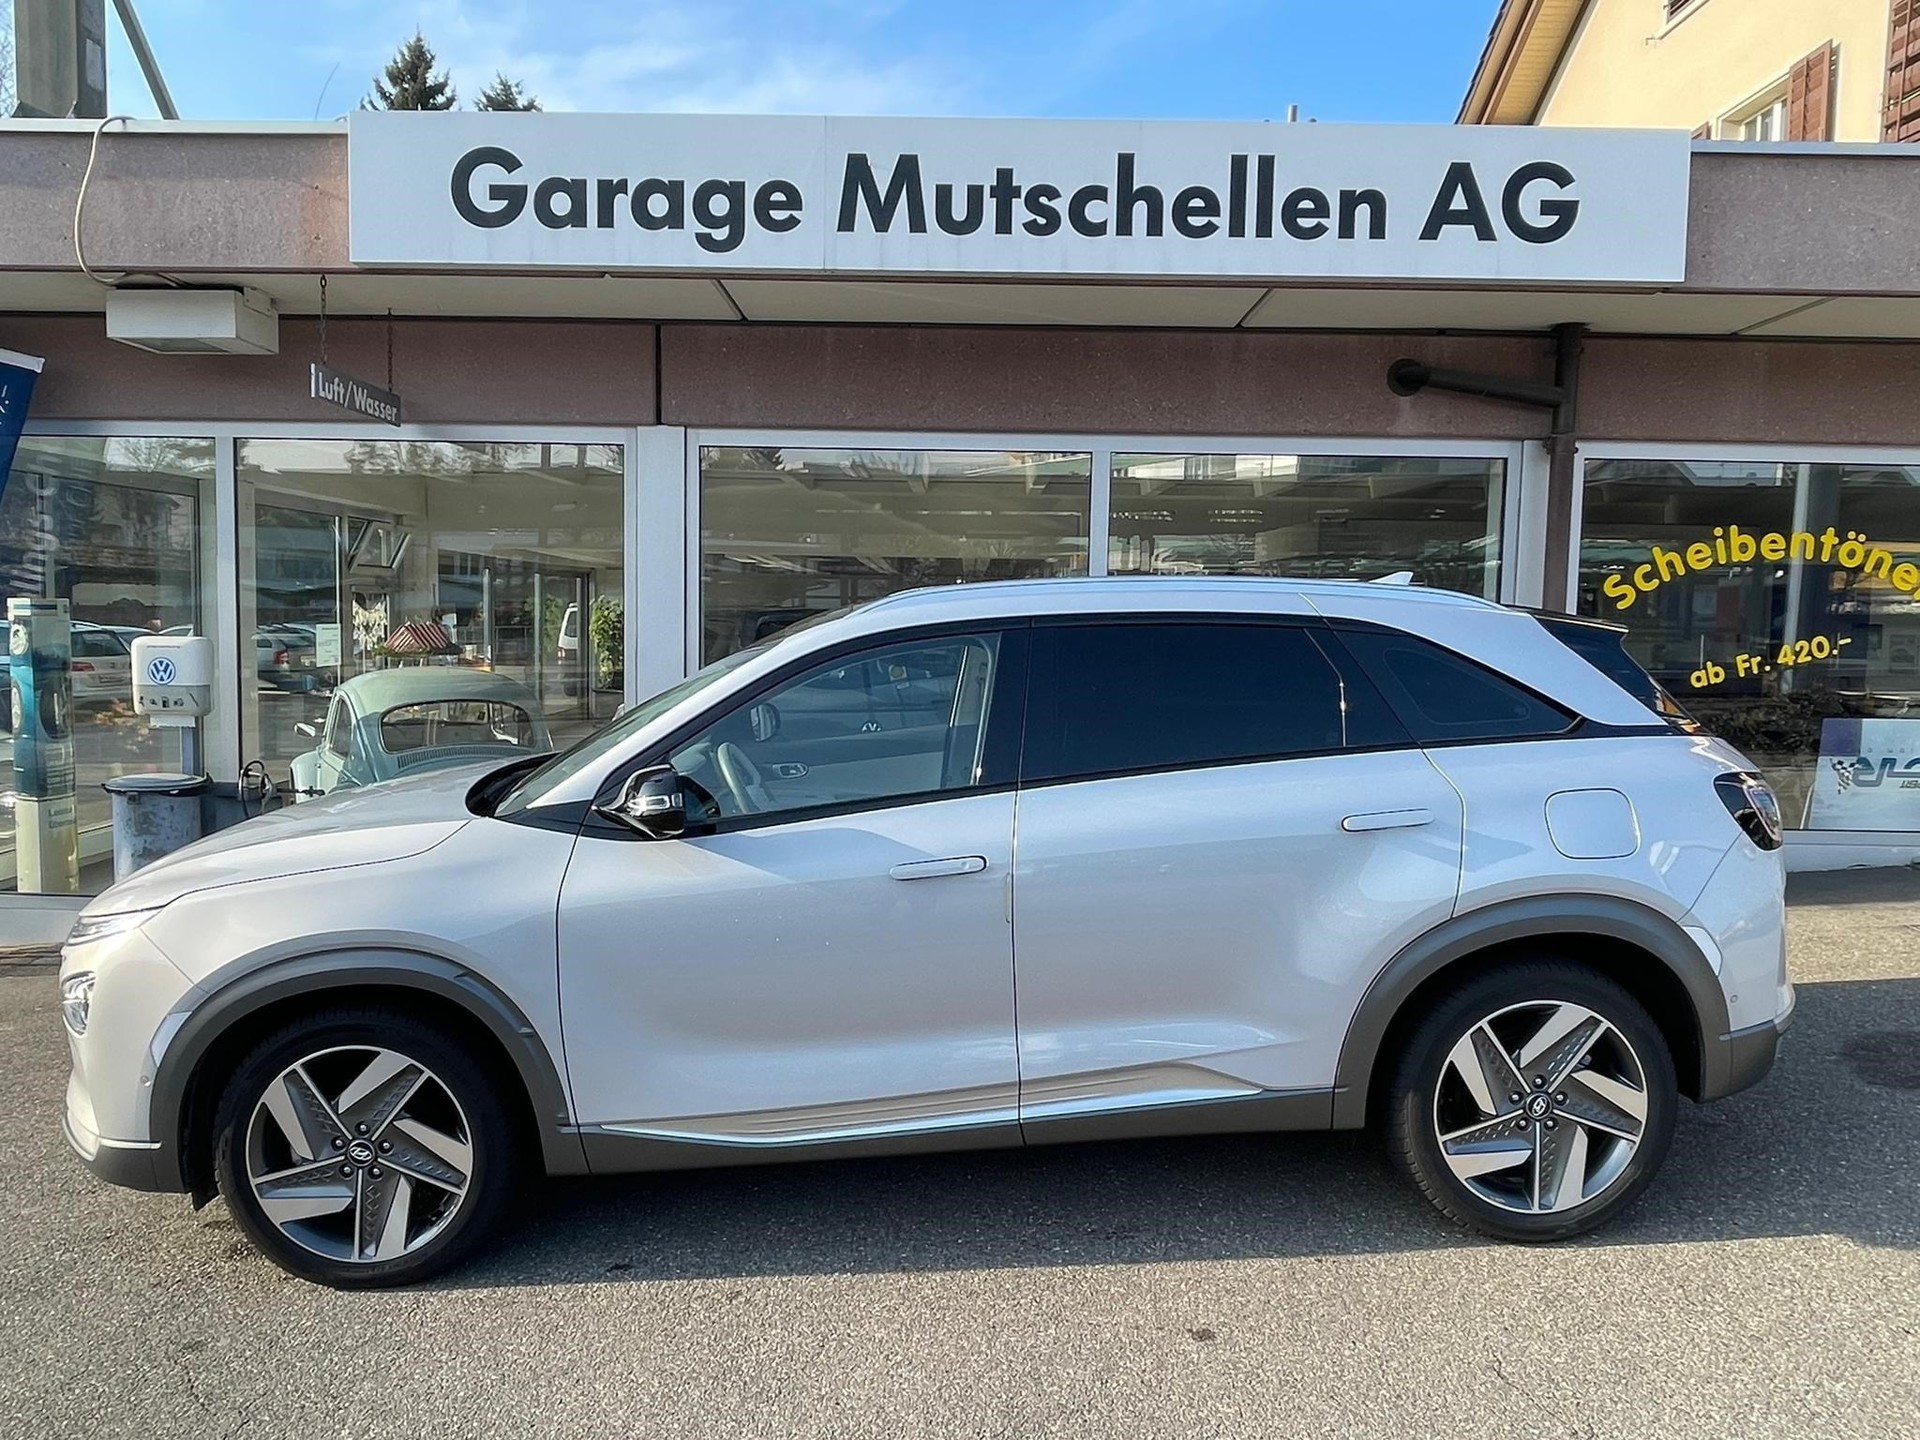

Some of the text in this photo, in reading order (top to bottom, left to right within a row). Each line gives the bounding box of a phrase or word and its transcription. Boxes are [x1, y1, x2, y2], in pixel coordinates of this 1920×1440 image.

[450, 146, 1580, 253] Garage Mutschellen AG
[318, 371, 398, 422] Luft/Wasser
[147, 656, 177, 686] VW
[1690, 635, 1852, 688] ab Fr. 420.-
